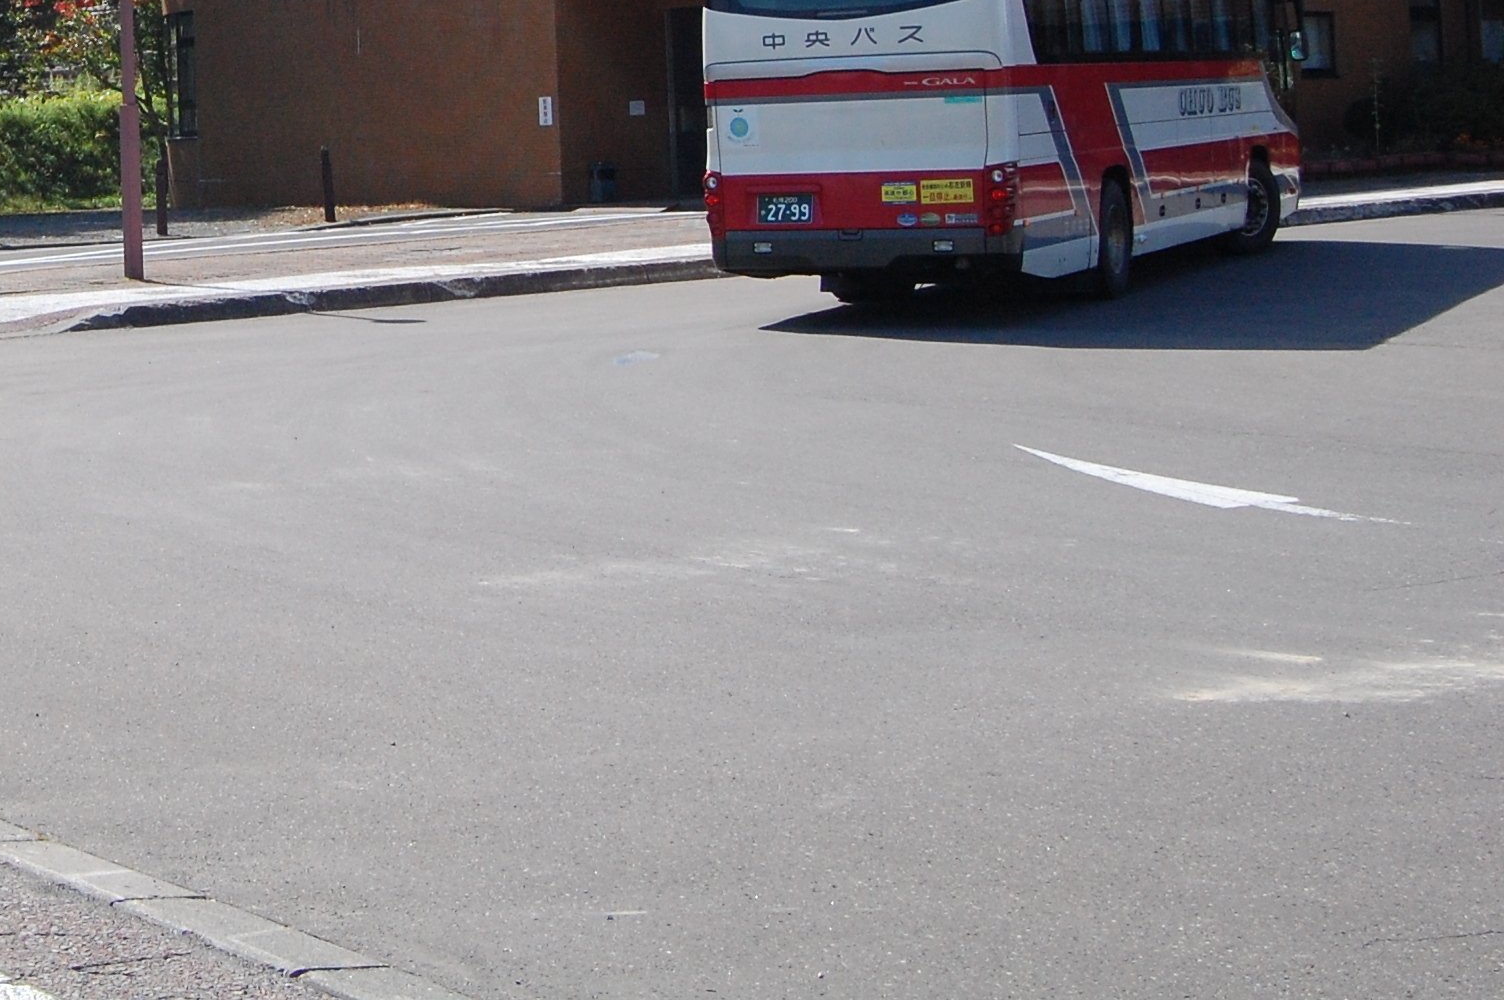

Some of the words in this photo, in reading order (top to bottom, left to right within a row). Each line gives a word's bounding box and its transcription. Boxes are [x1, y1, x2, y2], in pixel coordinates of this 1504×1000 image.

[762, 26, 924, 50] 中央バス
[922, 77, 976, 86] GALA
[767, 204, 809, 221] 27-99
